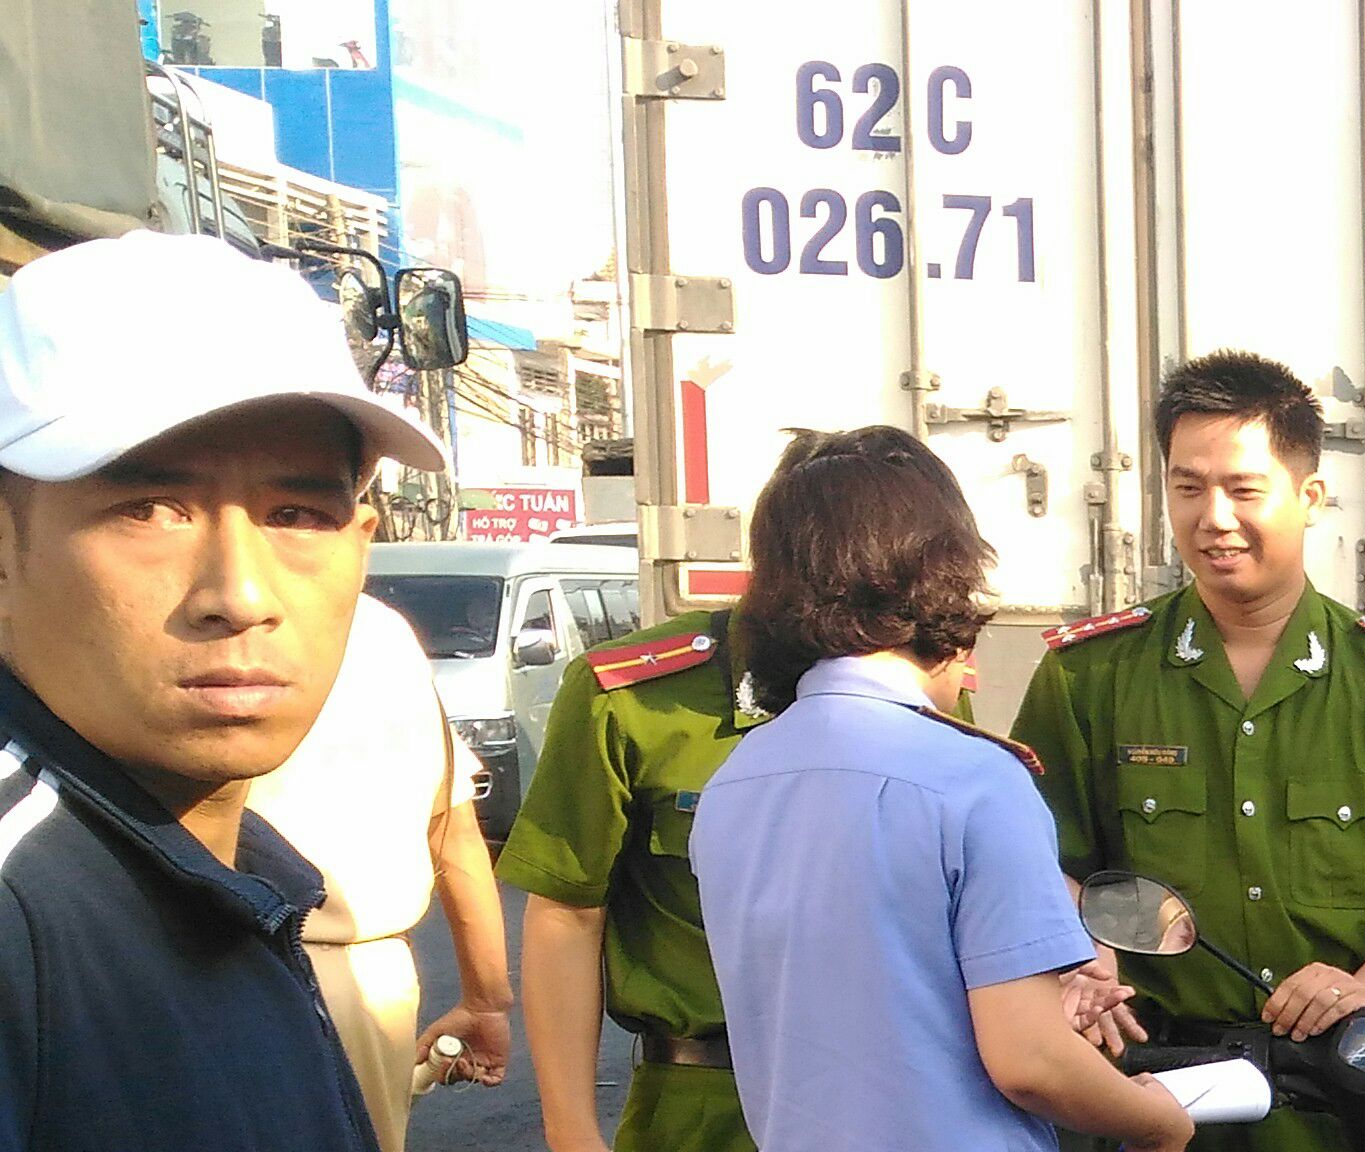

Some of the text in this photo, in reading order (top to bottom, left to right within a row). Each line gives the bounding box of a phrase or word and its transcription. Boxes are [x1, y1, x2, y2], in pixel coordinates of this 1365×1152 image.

[795, 60, 973, 155] 62 C
[741, 186, 1036, 283] 026.71
